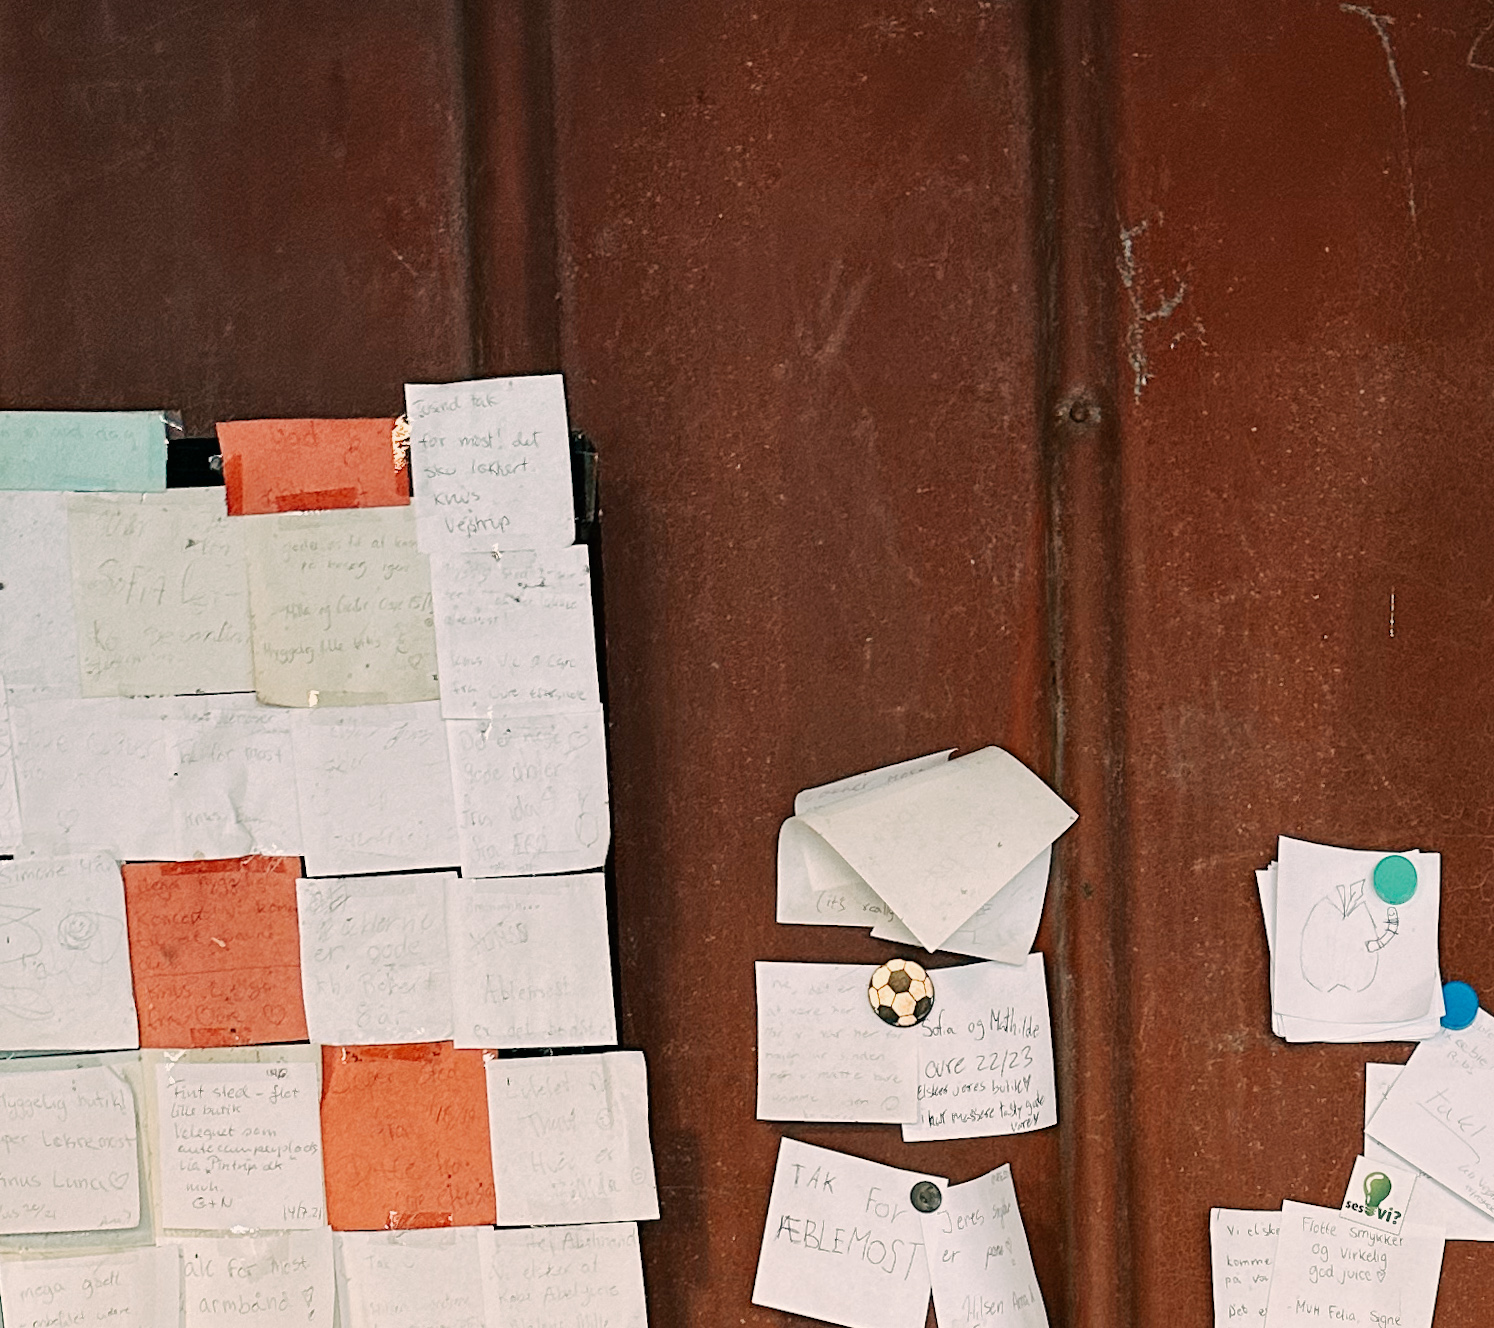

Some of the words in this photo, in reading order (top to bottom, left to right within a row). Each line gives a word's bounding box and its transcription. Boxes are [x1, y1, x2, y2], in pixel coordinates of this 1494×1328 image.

[976, 1047, 1034, 1078] 22/23
[792, 1163, 836, 1195] TAK
[1302, 1216, 1338, 1237] Flotte
[1345, 1200, 1364, 1213] ses
[1377, 1207, 1402, 1225] vi?
[774, 1214, 926, 1281] ÆBLEMOST
